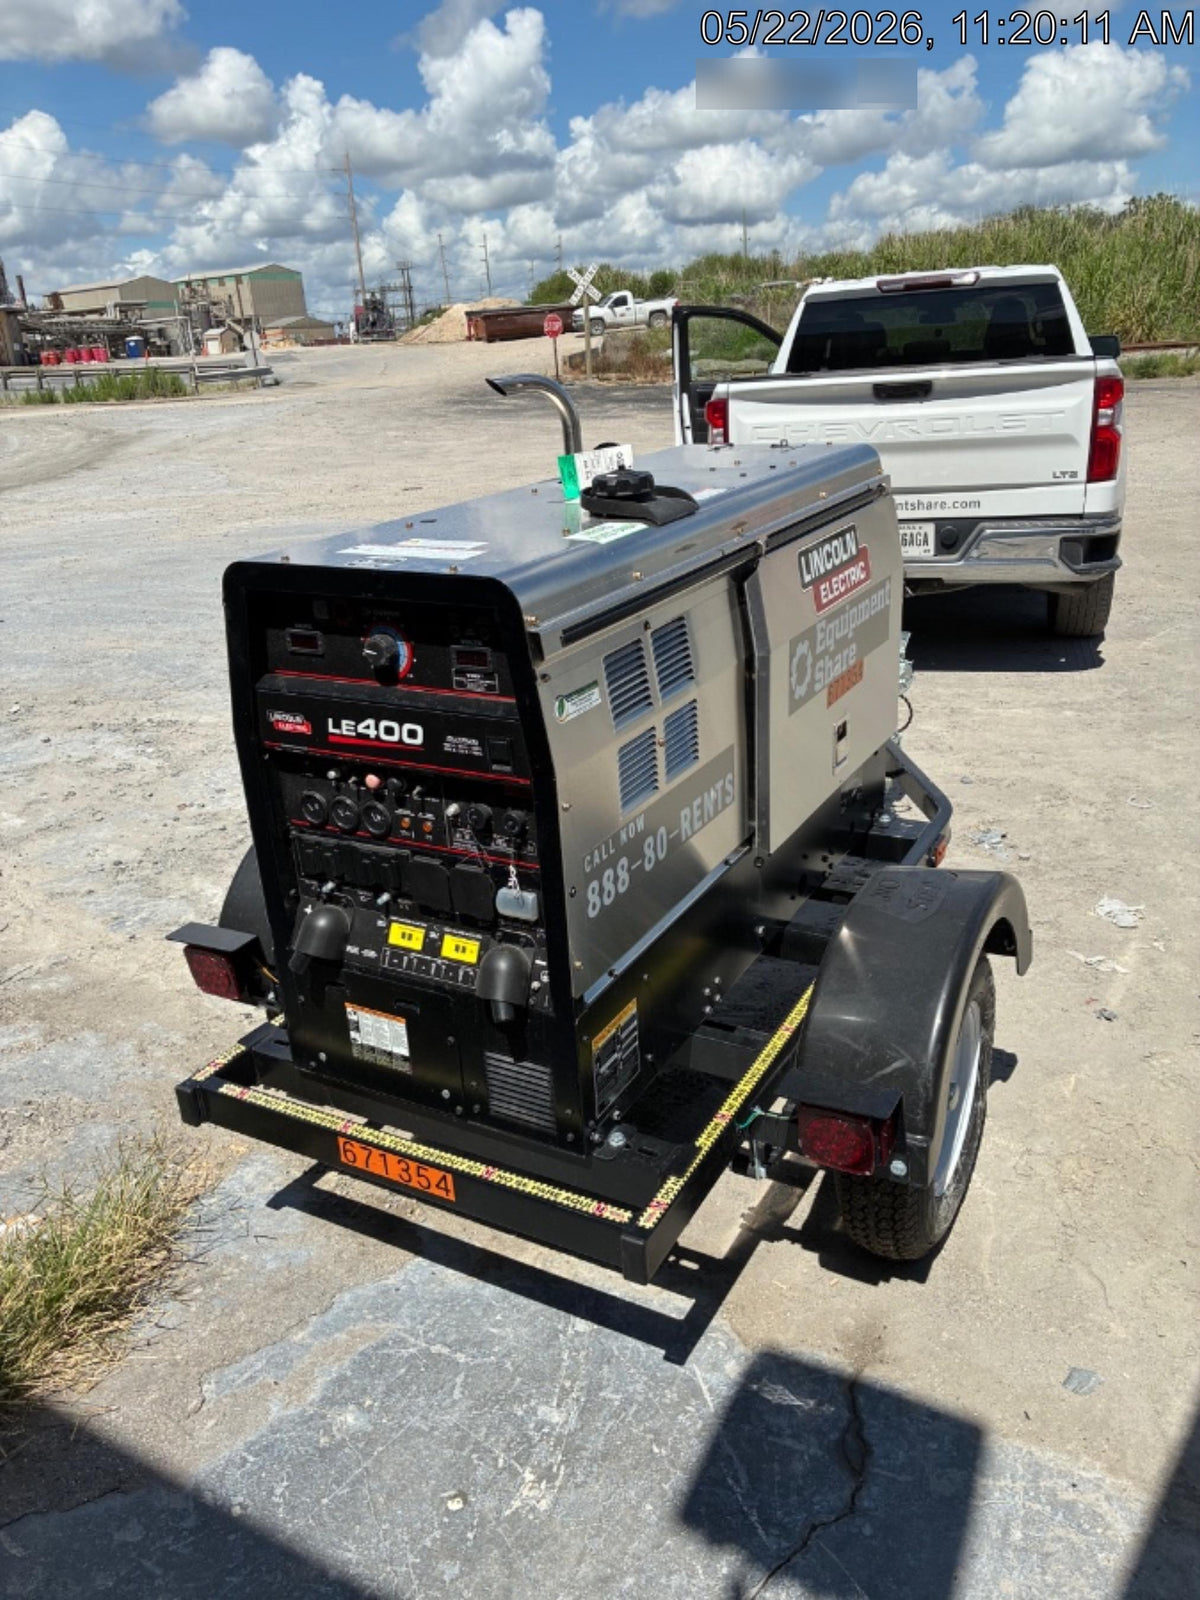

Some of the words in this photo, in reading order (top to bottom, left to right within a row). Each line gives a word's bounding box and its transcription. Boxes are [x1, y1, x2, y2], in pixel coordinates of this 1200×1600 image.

[751, 409, 1065, 444] CHEVROLET
[801, 531, 858, 584] LINCOLN
[820, 561, 867, 604] ELECTRIC
[815, 583, 891, 654] Equipment
[813, 643, 857, 692] Share
[327, 717, 424, 746] LE400
[584, 838, 615, 873] CALL
[619, 813, 645, 846] NOW
[586, 772, 735, 918] 888-80-RENTS
[342, 1140, 452, 1197] 671354
